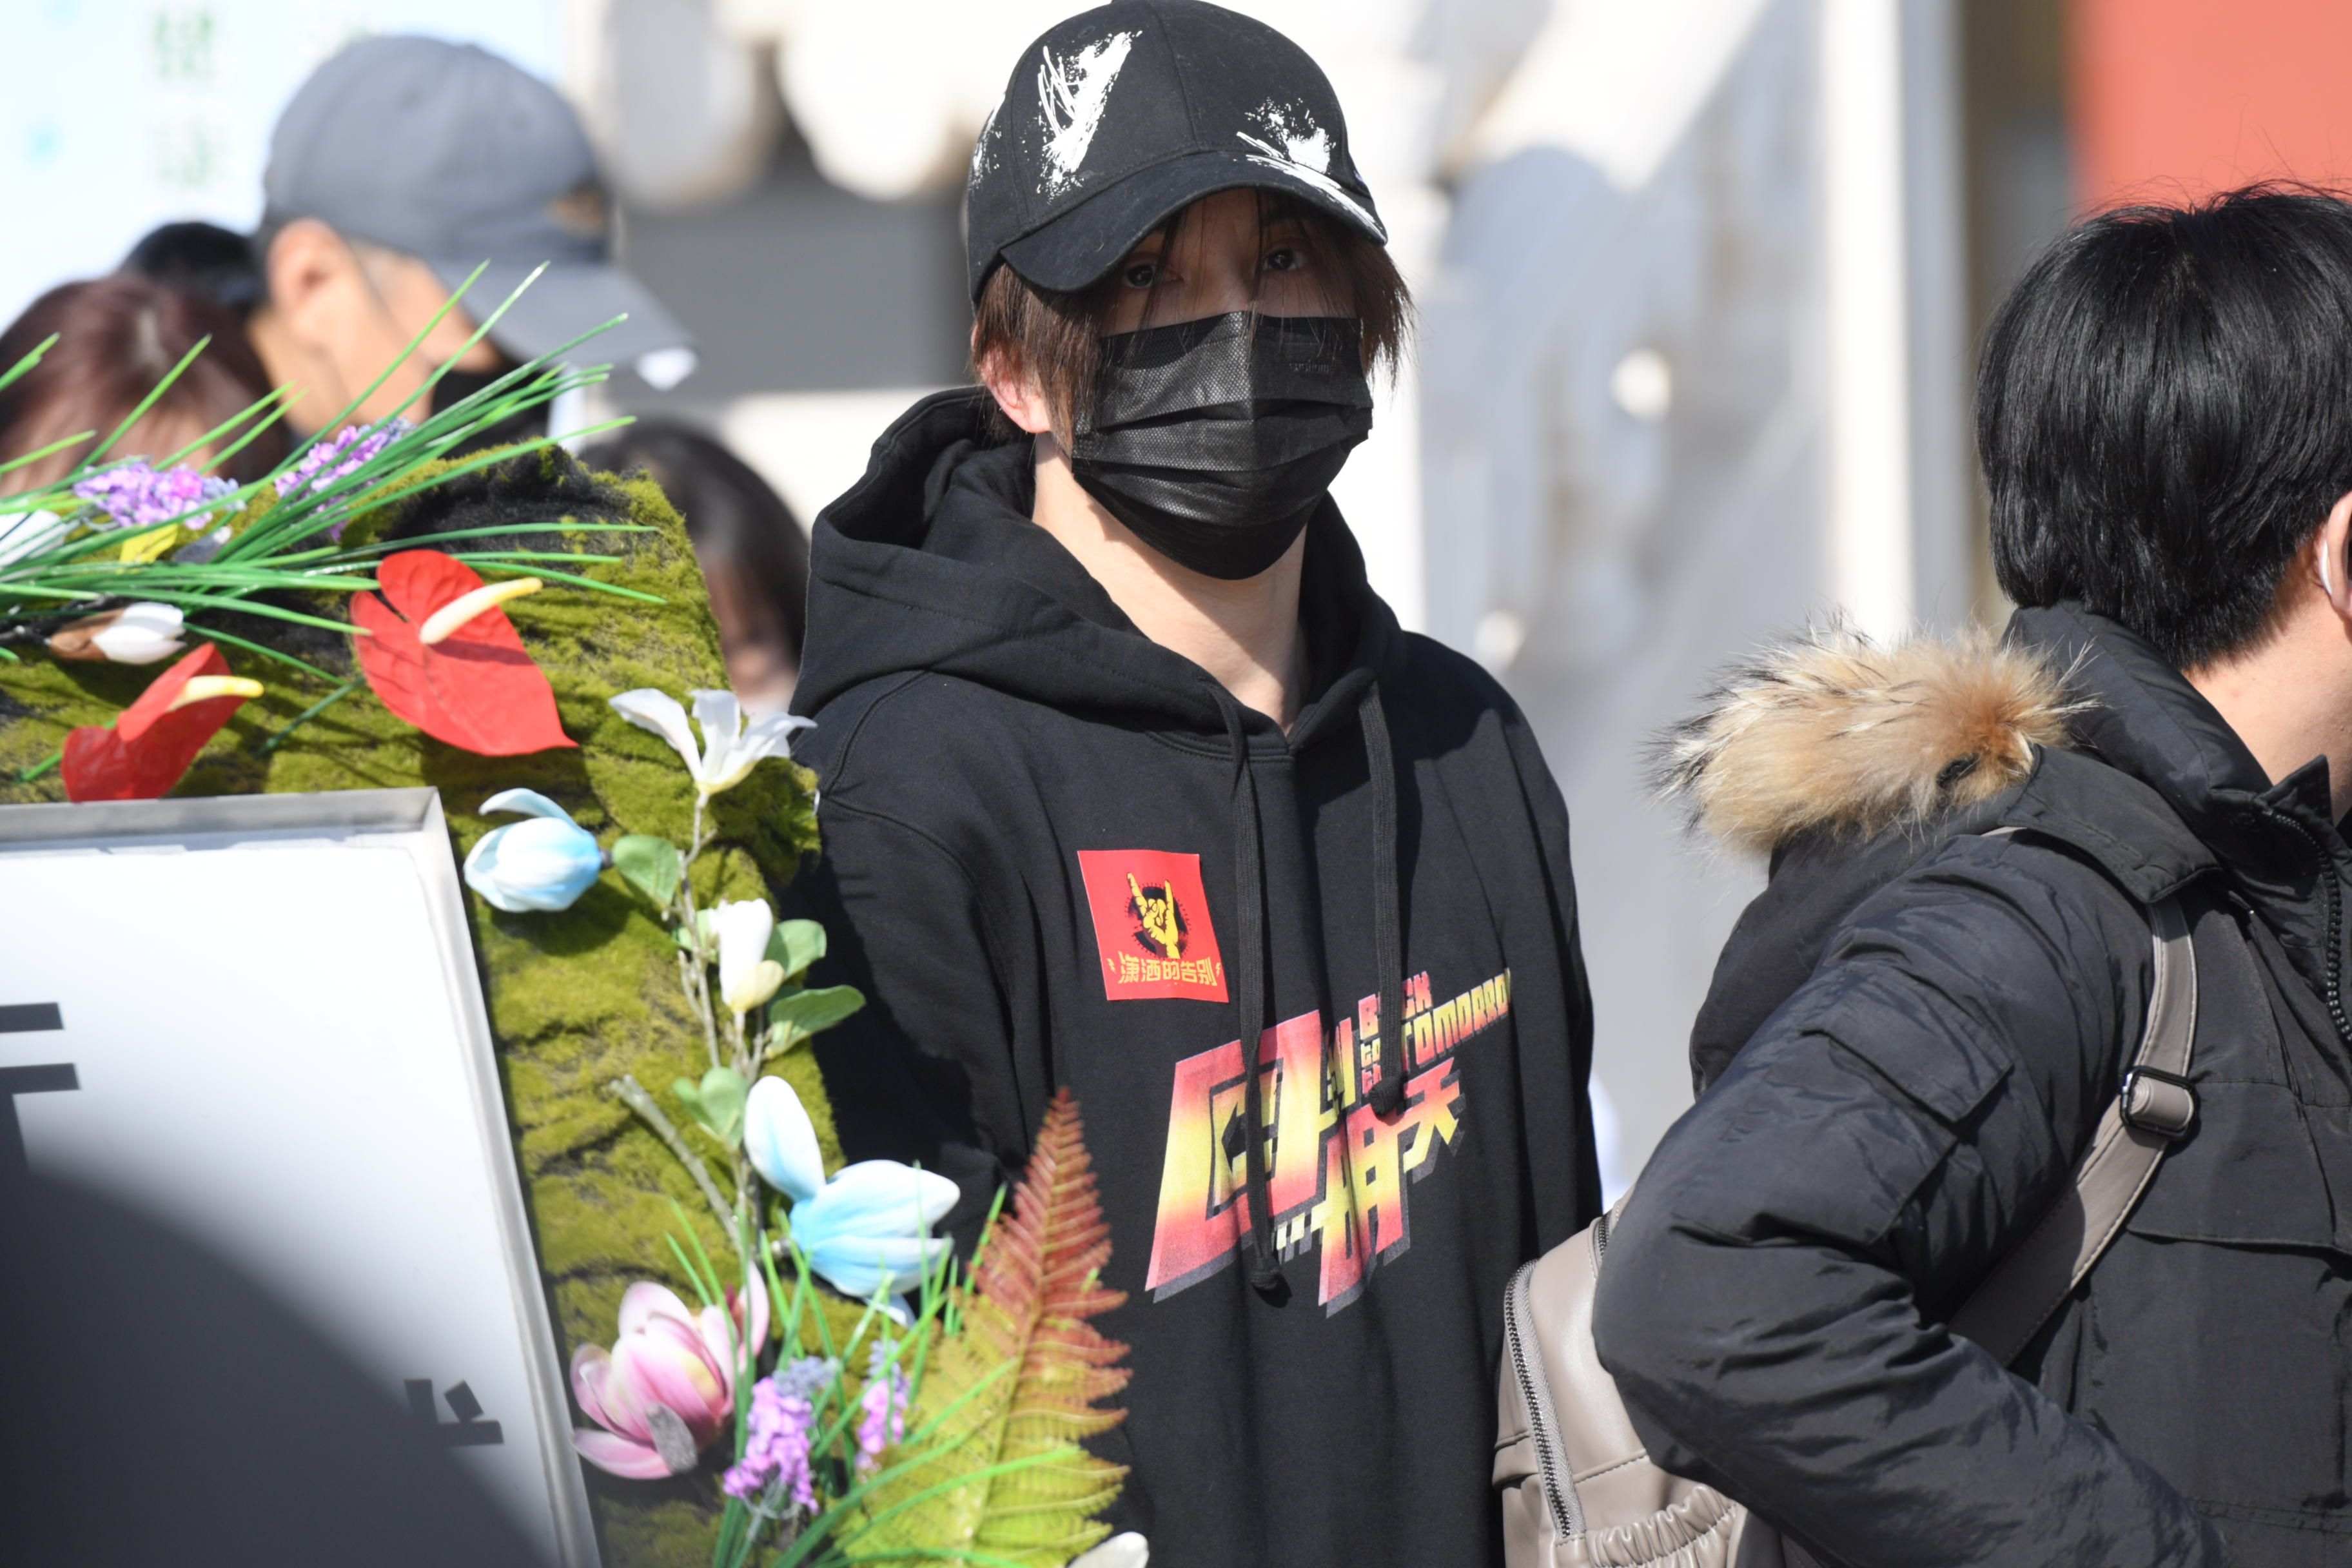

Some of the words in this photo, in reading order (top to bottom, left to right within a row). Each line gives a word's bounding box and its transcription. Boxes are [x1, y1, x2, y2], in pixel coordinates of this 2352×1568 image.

[1118, 951, 1217, 986] 潇洒的告别
[1358, 970, 1433, 1039] BCK
[1401, 968, 1511, 1072] TOMORRO
